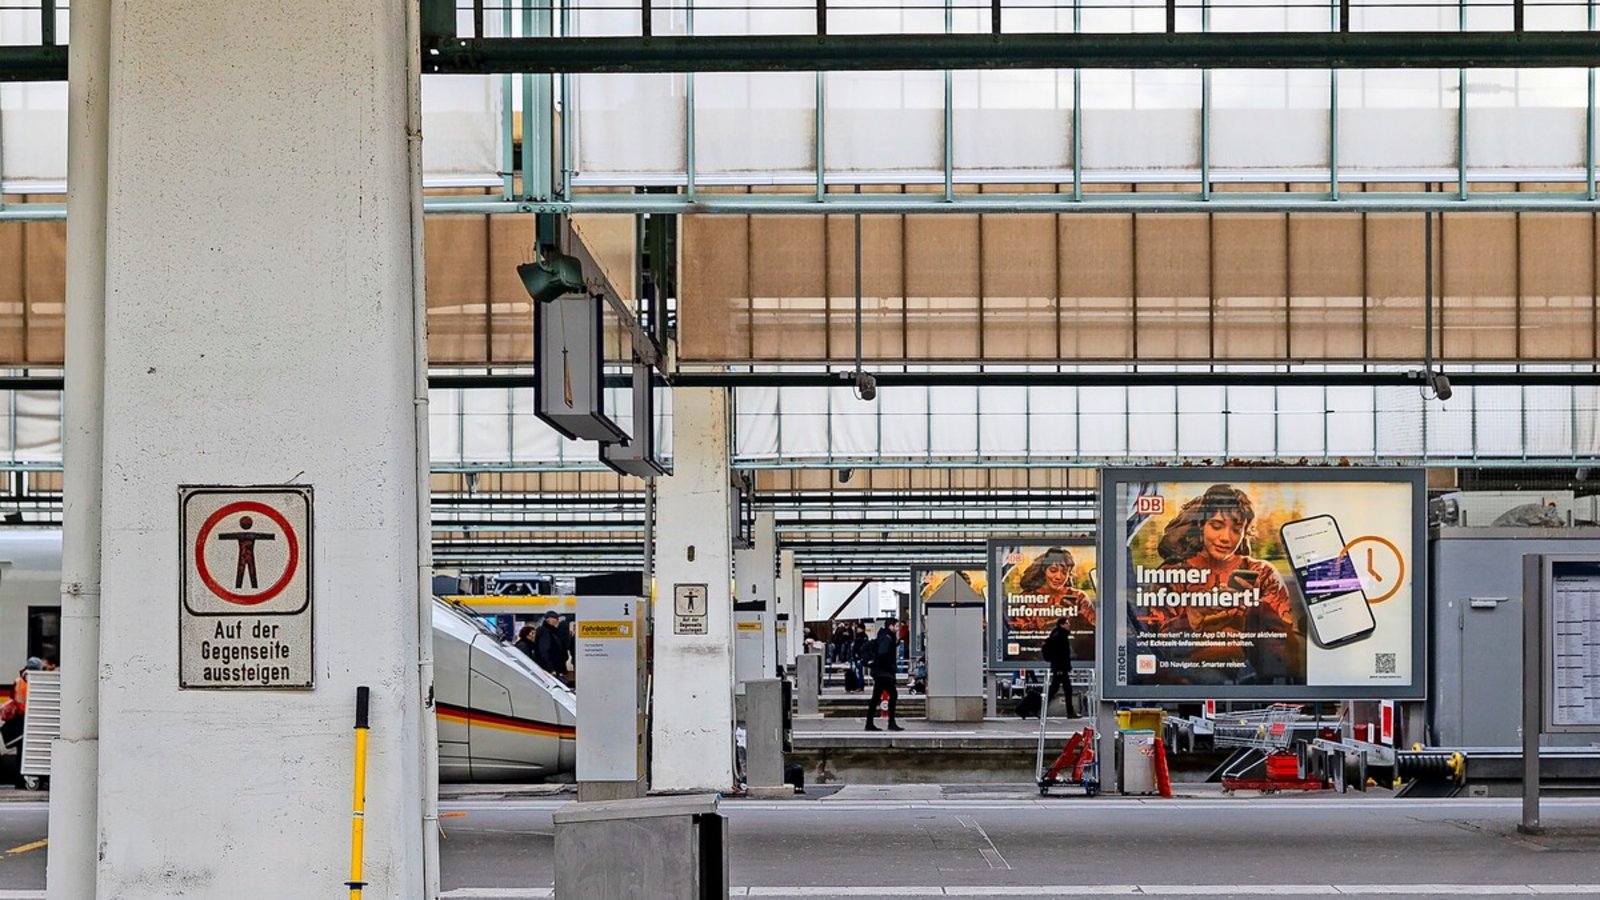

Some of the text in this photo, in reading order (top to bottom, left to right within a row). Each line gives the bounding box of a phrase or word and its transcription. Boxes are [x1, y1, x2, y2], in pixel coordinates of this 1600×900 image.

[1140, 498, 1161, 511] DB
[1136, 564, 1211, 584] Immer
[1007, 592, 1050, 604] Immer
[1136, 586, 1261, 607] informiert!
[1007, 605, 1078, 617] informiert!
[214, 619, 279, 639] Auf der
[1184, 631, 1190, 639] in
[1191, 631, 1201, 639] der
[1202, 632, 1215, 640] App
[1216, 631, 1226, 639] DB
[1227, 631, 1256, 640] Navigator
[1257, 631, 1288, 639] aktivieren
[1150, 639, 1226, 647] Echtzeit-Informationen
[201, 640, 290, 664] Gegenseite
[1170, 660, 1201, 669] Navigator.
[203, 664, 290, 684] aussteigen
